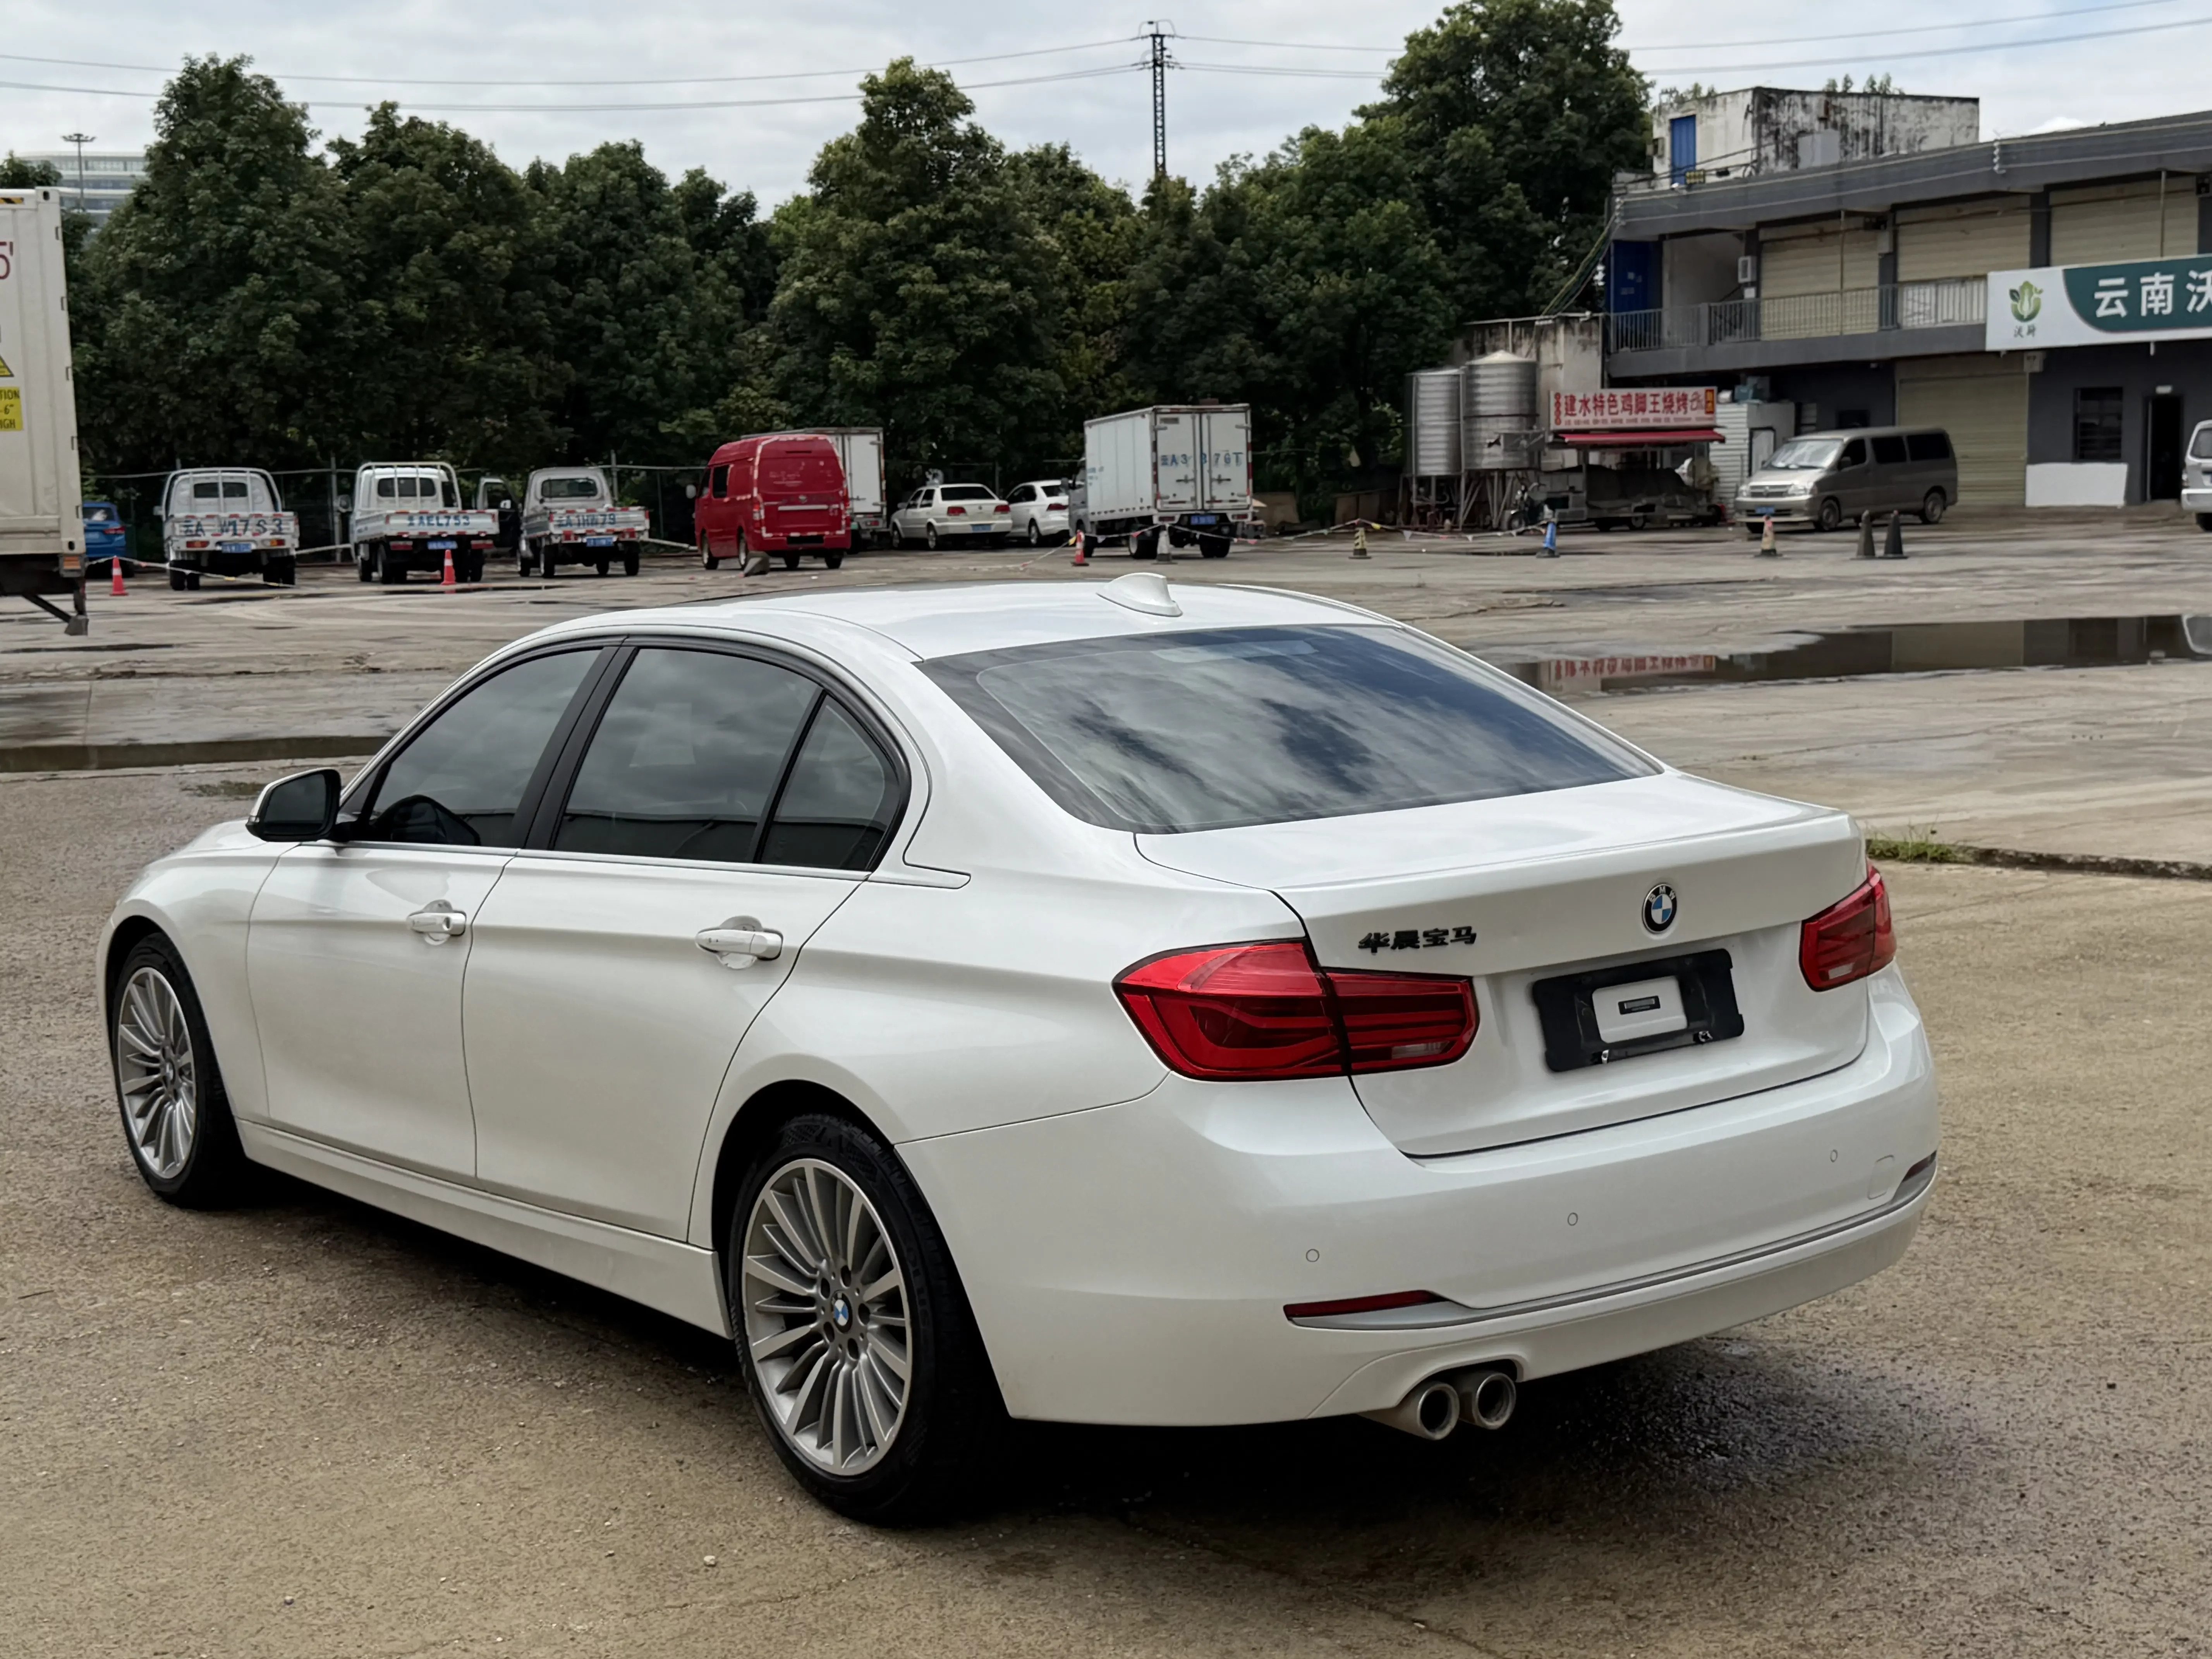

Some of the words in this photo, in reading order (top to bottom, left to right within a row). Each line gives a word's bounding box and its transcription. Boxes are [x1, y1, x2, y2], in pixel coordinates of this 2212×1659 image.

[1648, 885, 1676, 902] BMW
[1358, 926, 1477, 954] 华晨宝马
